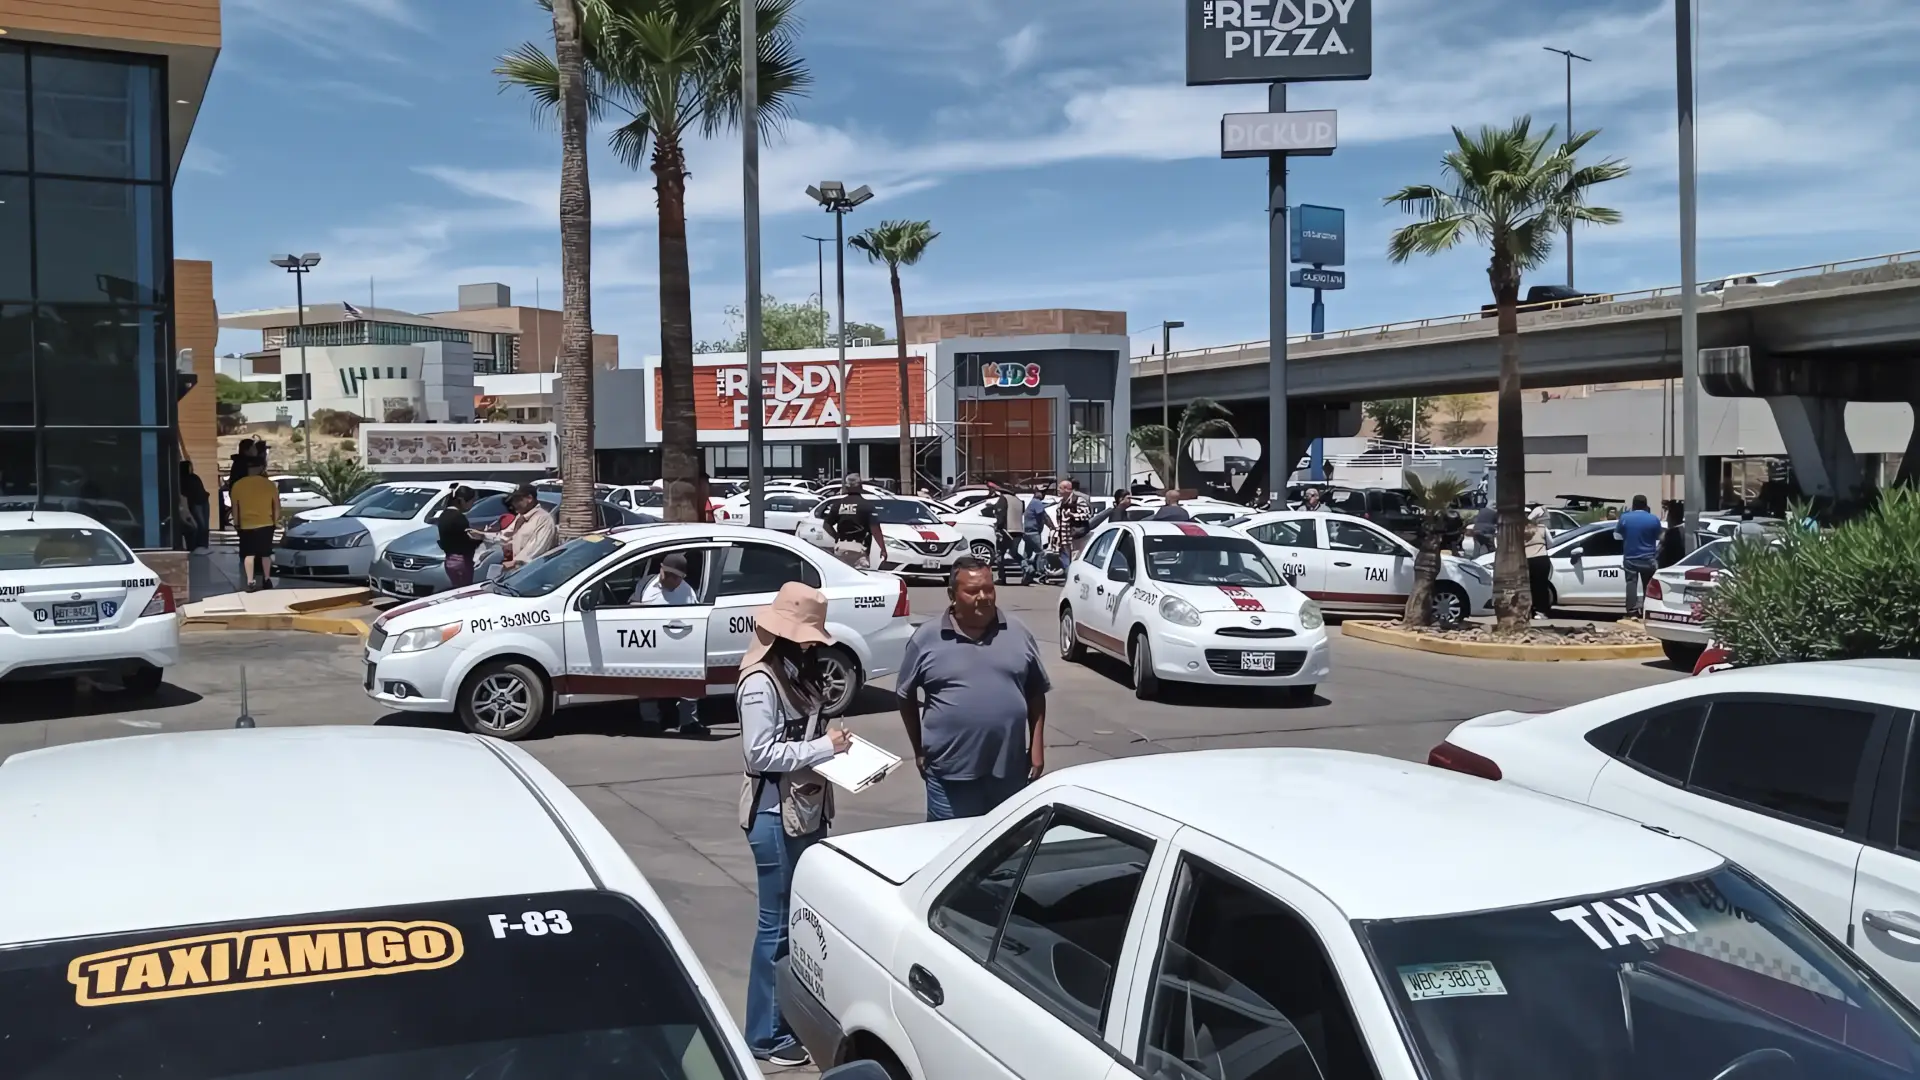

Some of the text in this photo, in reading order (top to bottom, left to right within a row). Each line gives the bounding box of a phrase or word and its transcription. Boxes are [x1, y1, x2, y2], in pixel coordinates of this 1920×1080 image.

[1204, 0, 1354, 32] THE READY
[1225, 27, 1349, 58] PIZZA
[1228, 121, 1333, 146] PICKUP
[716, 368, 725, 397] THE
[982, 362, 1041, 387] KIDS
[733, 397, 842, 427] PZZA
[1364, 567, 1389, 582] TAXI
[1598, 570, 1619, 578] TAXI
[36, 610, 47, 621] 10
[729, 616, 756, 634] SON
[616, 629, 656, 649] TAXI
[488, 909, 573, 939] F-83
[1551, 892, 1699, 950] TAXI
[88, 928, 448, 994] TAXI AMIGO
[1407, 969, 1492, 991] WBC-380-B
